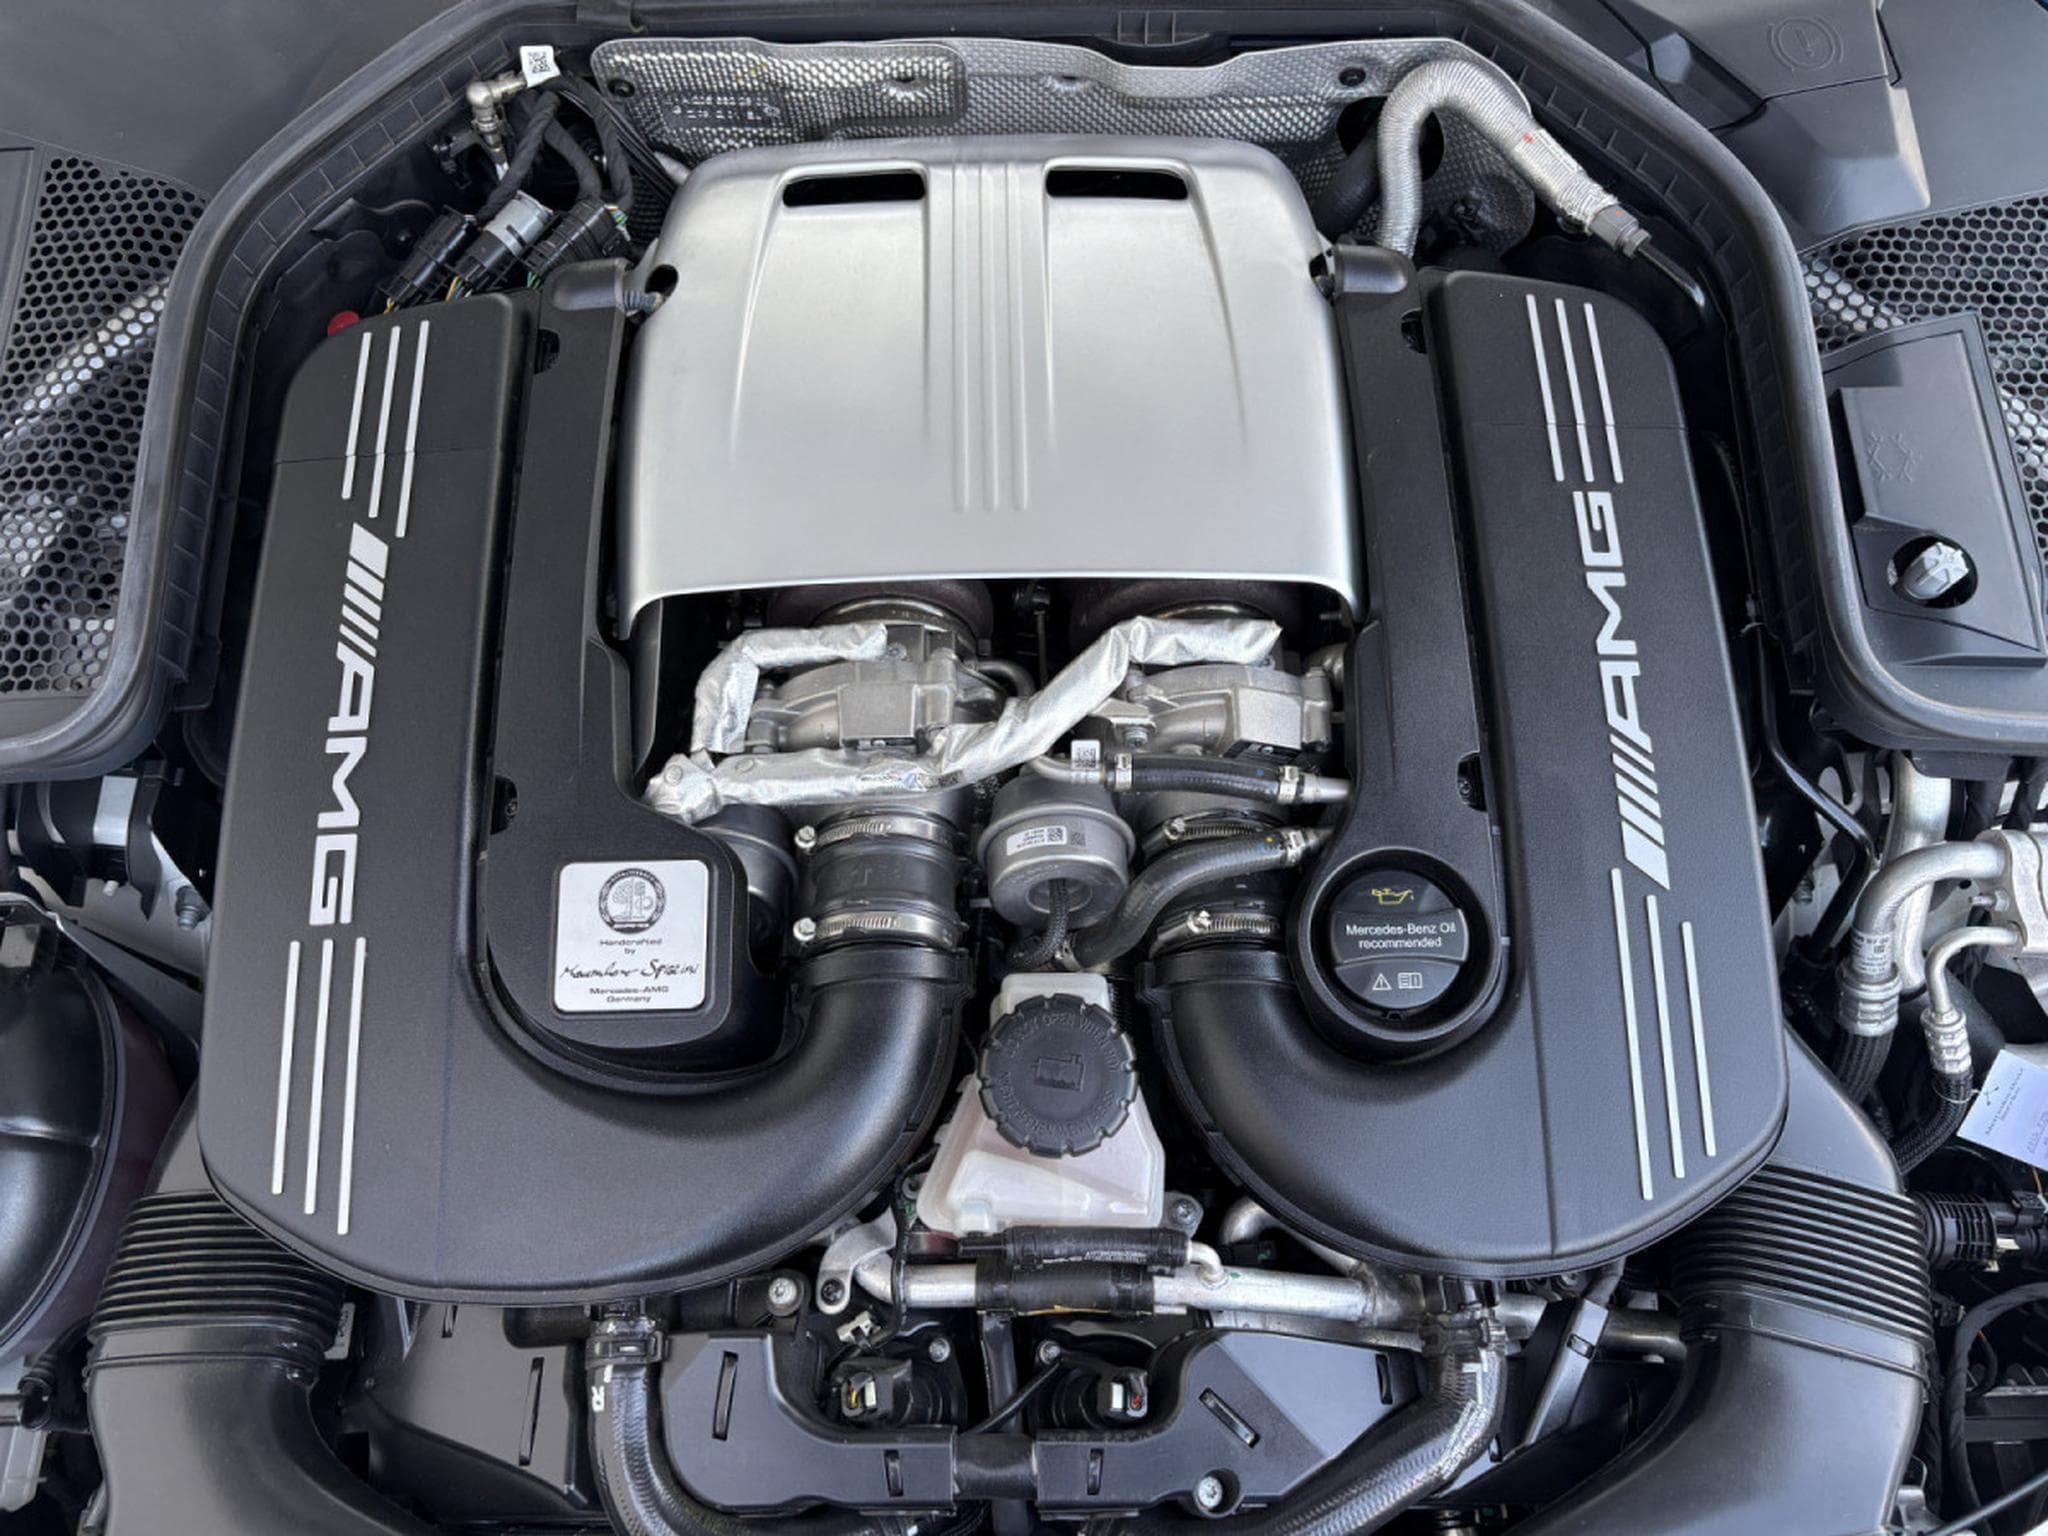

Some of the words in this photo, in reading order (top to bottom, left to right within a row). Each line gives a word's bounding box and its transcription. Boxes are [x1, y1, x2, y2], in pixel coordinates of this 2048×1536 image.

[1573, 491, 1653, 753] AMG
[309, 641, 375, 926] AMG
[1346, 923, 1437, 936] Mercedes-Benz
[1440, 922, 1456, 933] Oil
[600, 938, 663, 946] Handcrafted
[1358, 936, 1442, 949] recommended
[624, 947, 636, 955] by
[589, 985, 669, 995] Mercedes-AMG
[606, 995, 652, 1004] Germany
[1043, 1011, 1076, 1027] OPEN
